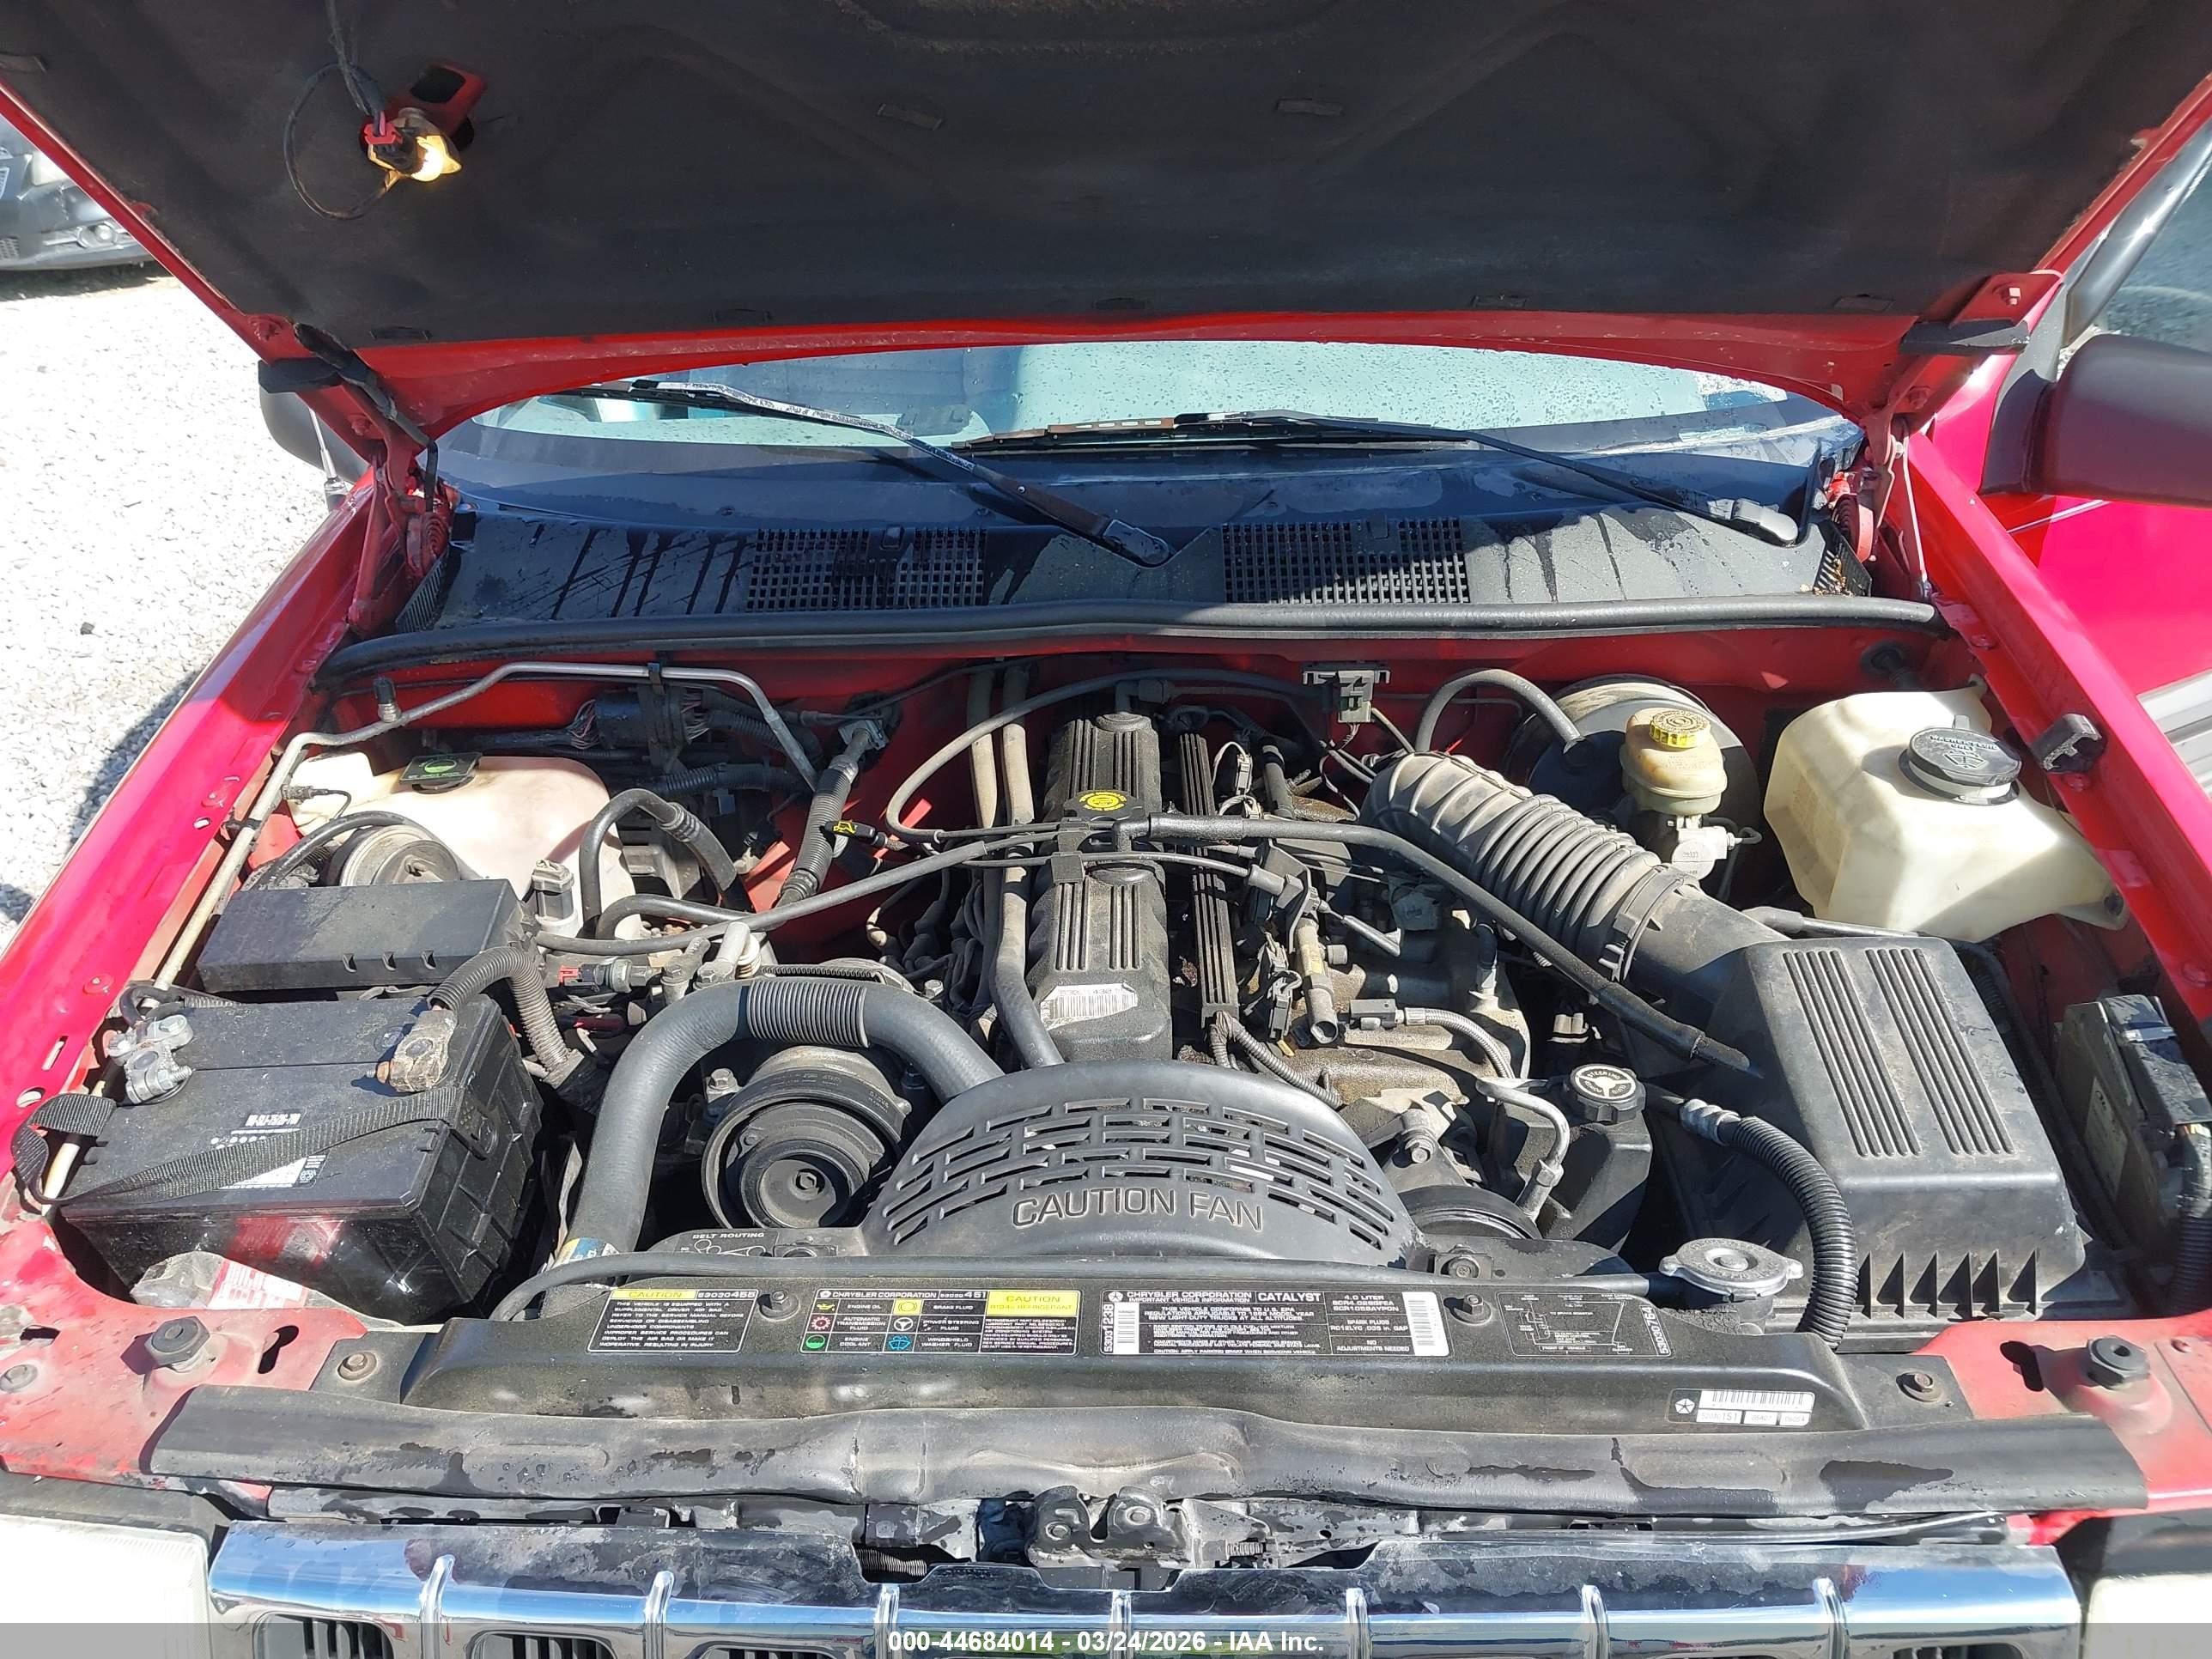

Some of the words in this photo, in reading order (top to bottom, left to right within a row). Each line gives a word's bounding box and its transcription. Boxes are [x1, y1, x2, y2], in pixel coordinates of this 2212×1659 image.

[1586, 1070, 1621, 1080] STEERING
[1012, 1188, 1176, 1229] CAUTION
[1188, 1191, 1263, 1232] FAN
[1258, 1291, 1322, 1302] CATALYST
[1103, 1304, 1114, 1352] 53031238
[1641, 1307, 1669, 1354] 53030764
